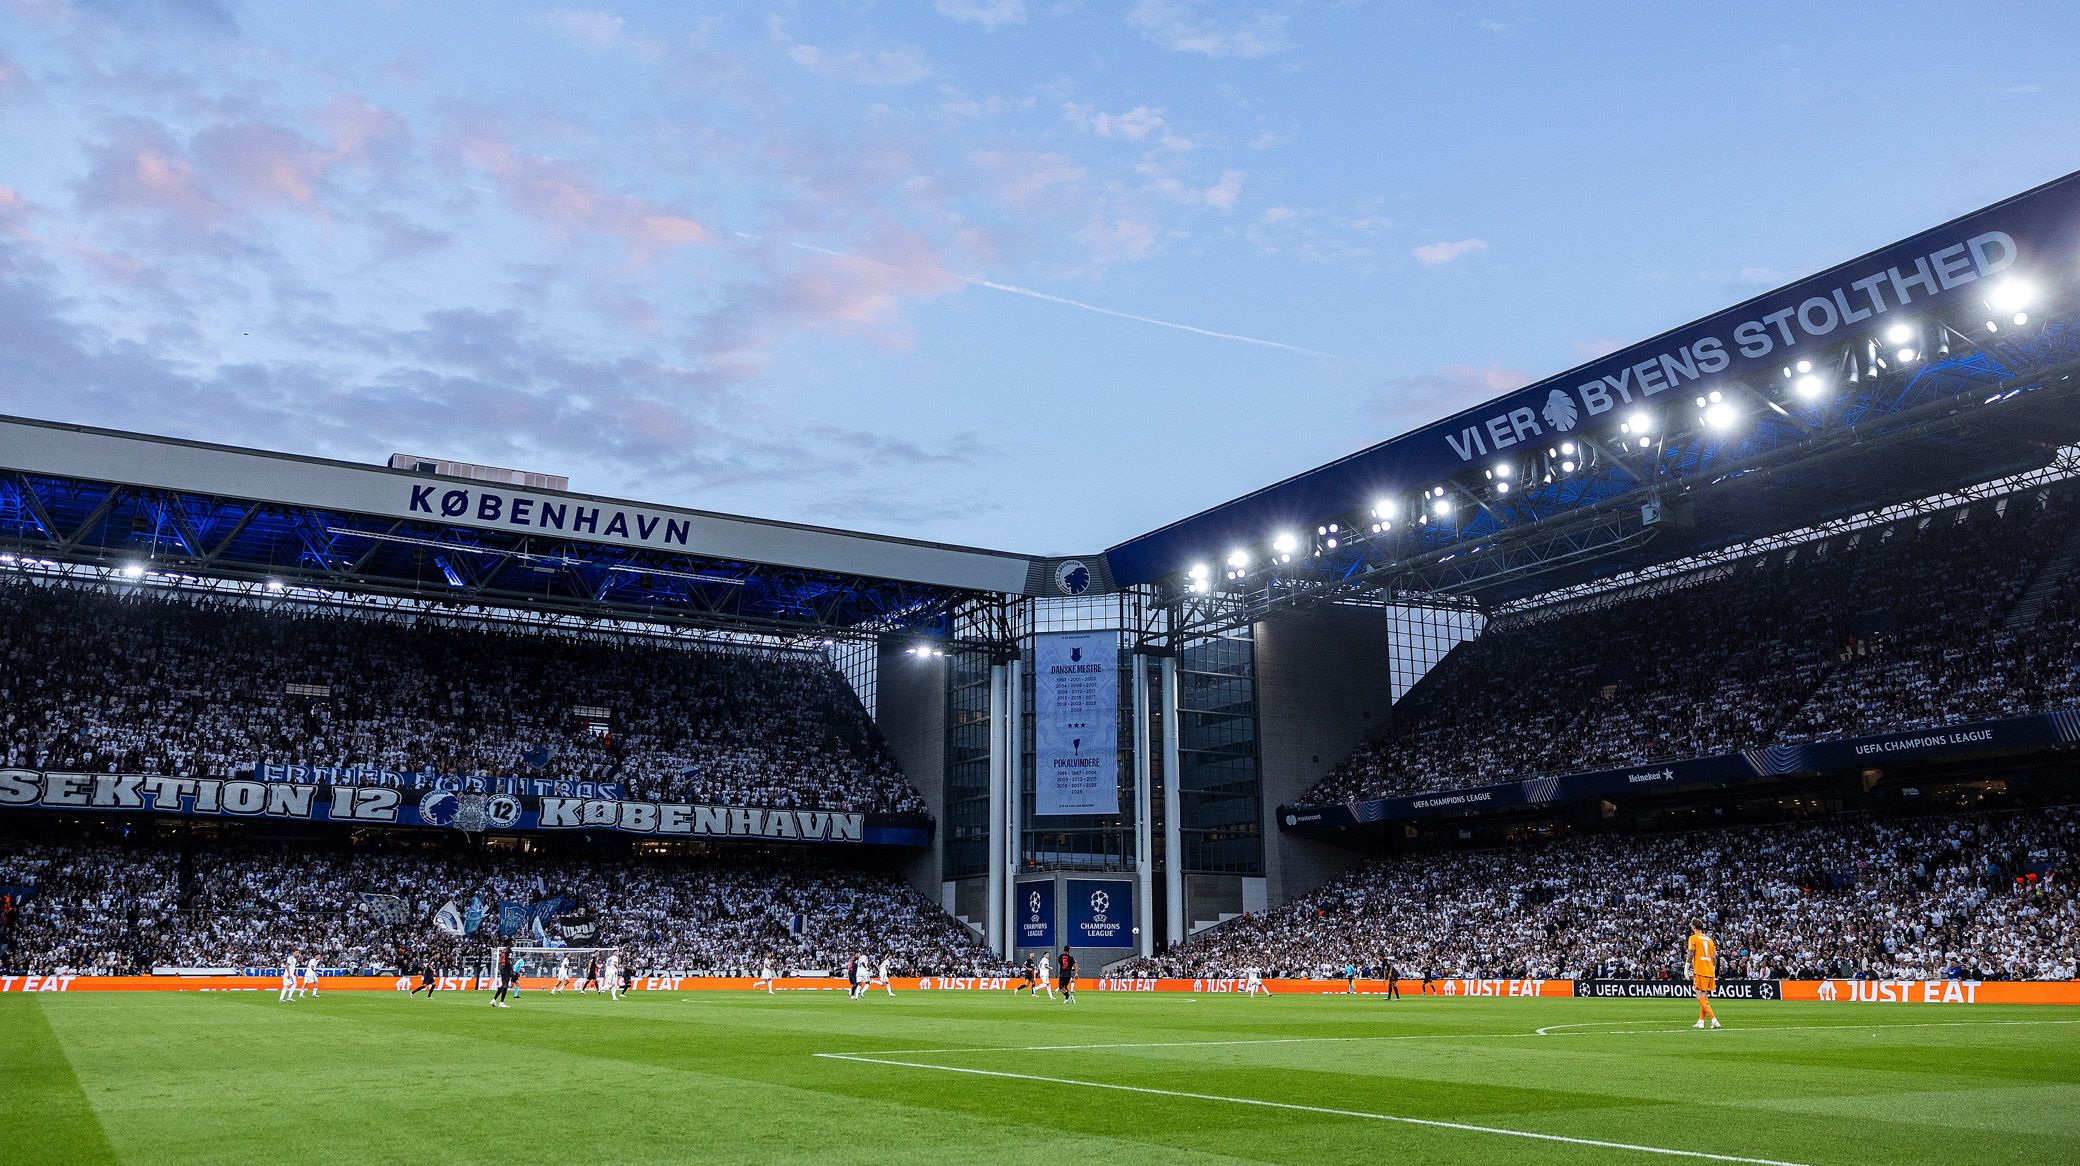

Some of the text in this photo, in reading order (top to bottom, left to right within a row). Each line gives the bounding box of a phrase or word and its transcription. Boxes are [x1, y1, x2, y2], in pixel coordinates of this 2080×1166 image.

[1445, 231, 2017, 462] VI ER BYENS STOLTHED
[409, 484, 691, 545] KØBENHAVN
[1051, 664, 1101, 674] DANSKE MESTRE
[1856, 729, 1993, 755] UEFA CHAMPIONS LEAGUE
[1054, 758, 1100, 768] POKALVINDERE
[1628, 771, 1661, 782] Heineken
[0, 768, 318, 818] SEKTION
[329, 786, 402, 823] 12
[1413, 793, 1492, 809] UEFA CHAMPIONS LEAGUE
[493, 801, 513, 820] 12
[538, 797, 864, 842] KØBENHAVN
[22, 976, 76, 992] EAT
[646, 978, 684, 990] EAT
[938, 978, 1010, 990] JUST EAT
[1110, 979, 1157, 992] JUST EAT
[1206, 979, 1236, 992] JUST
[1462, 980, 1544, 996] JUST EAT
[1596, 984, 1626, 996] UEFA
[1847, 981, 1982, 1003] JUST EAT
